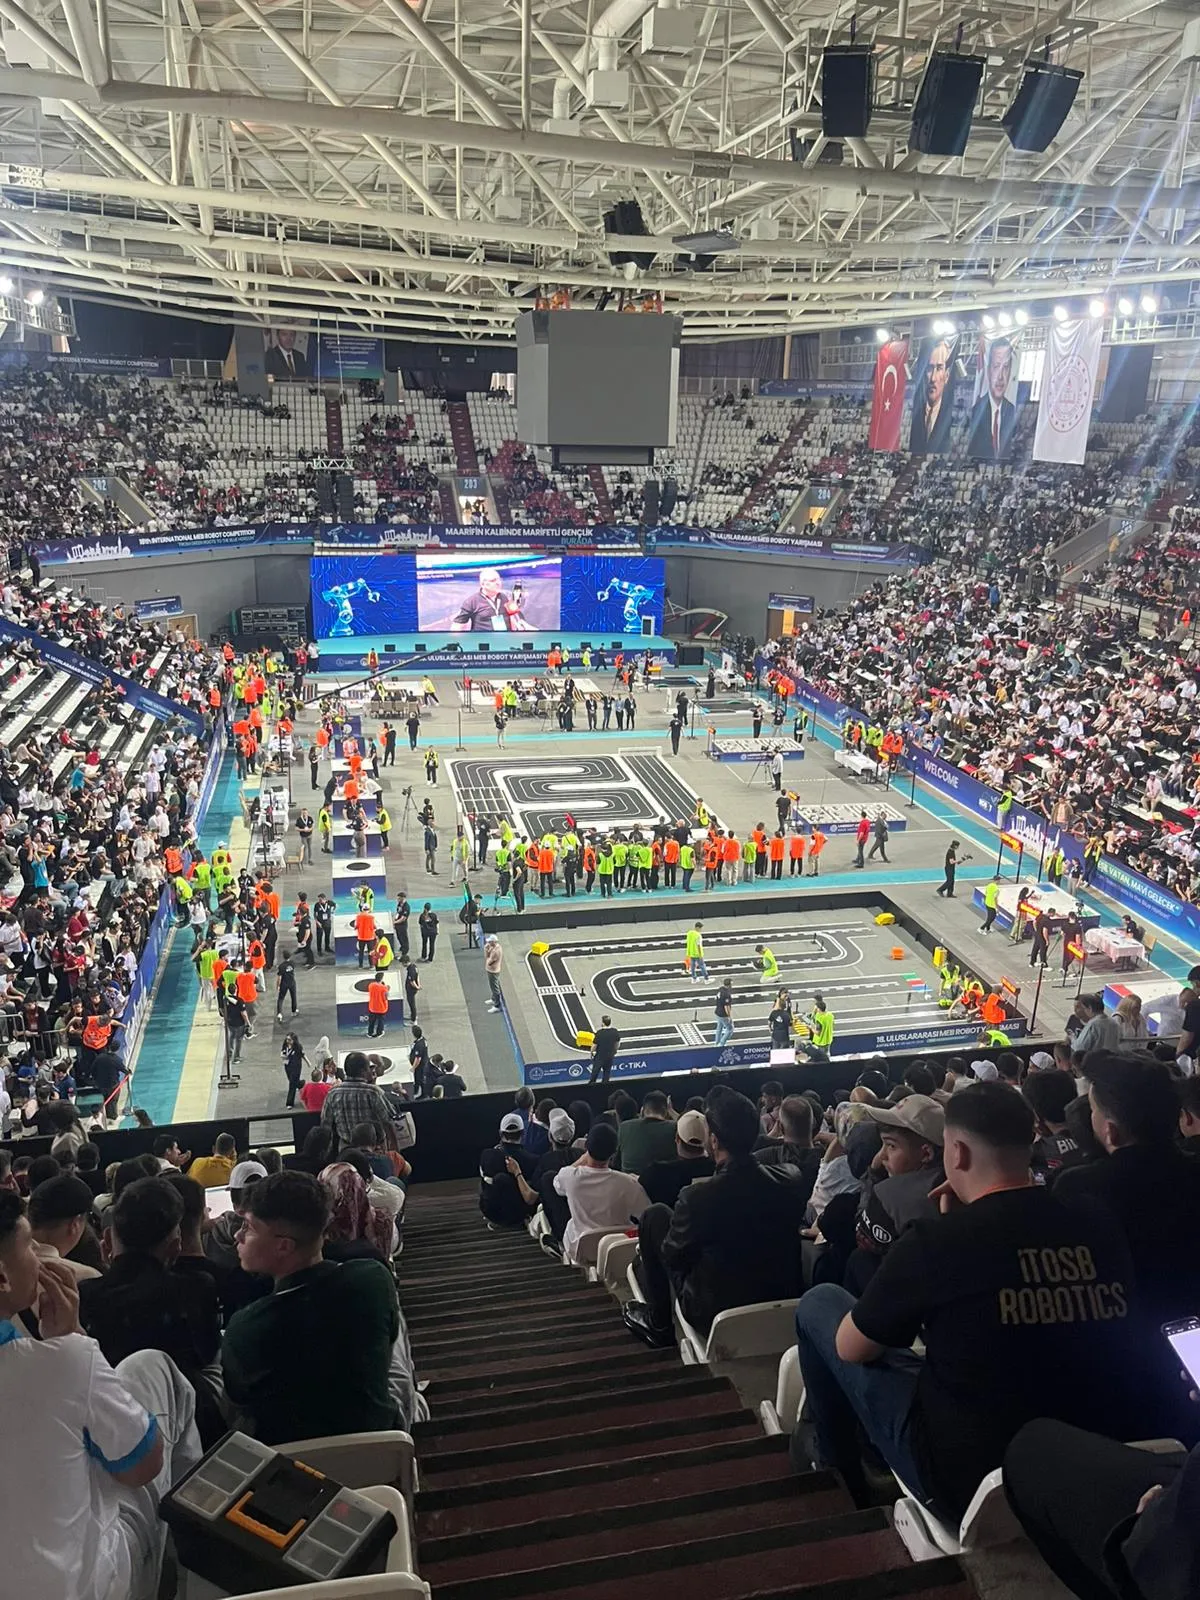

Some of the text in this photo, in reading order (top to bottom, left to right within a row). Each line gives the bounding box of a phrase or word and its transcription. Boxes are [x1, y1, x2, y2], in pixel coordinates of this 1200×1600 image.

[463, 478, 478, 489] 203
[152, 534, 194, 545] INTERNATIONAL
[204, 531, 223, 540] ROBOT
[222, 529, 256, 538] COMPETITION
[487, 653, 508, 661] ROBOT
[509, 653, 549, 662] YARIŞMASI'N
[923, 758, 960, 789] WELCOME
[886, 1031, 939, 1042] ULUSLARARASI
[955, 1027, 981, 1036] ROBOT
[999, 1281, 1128, 1325] ROBOTICS
